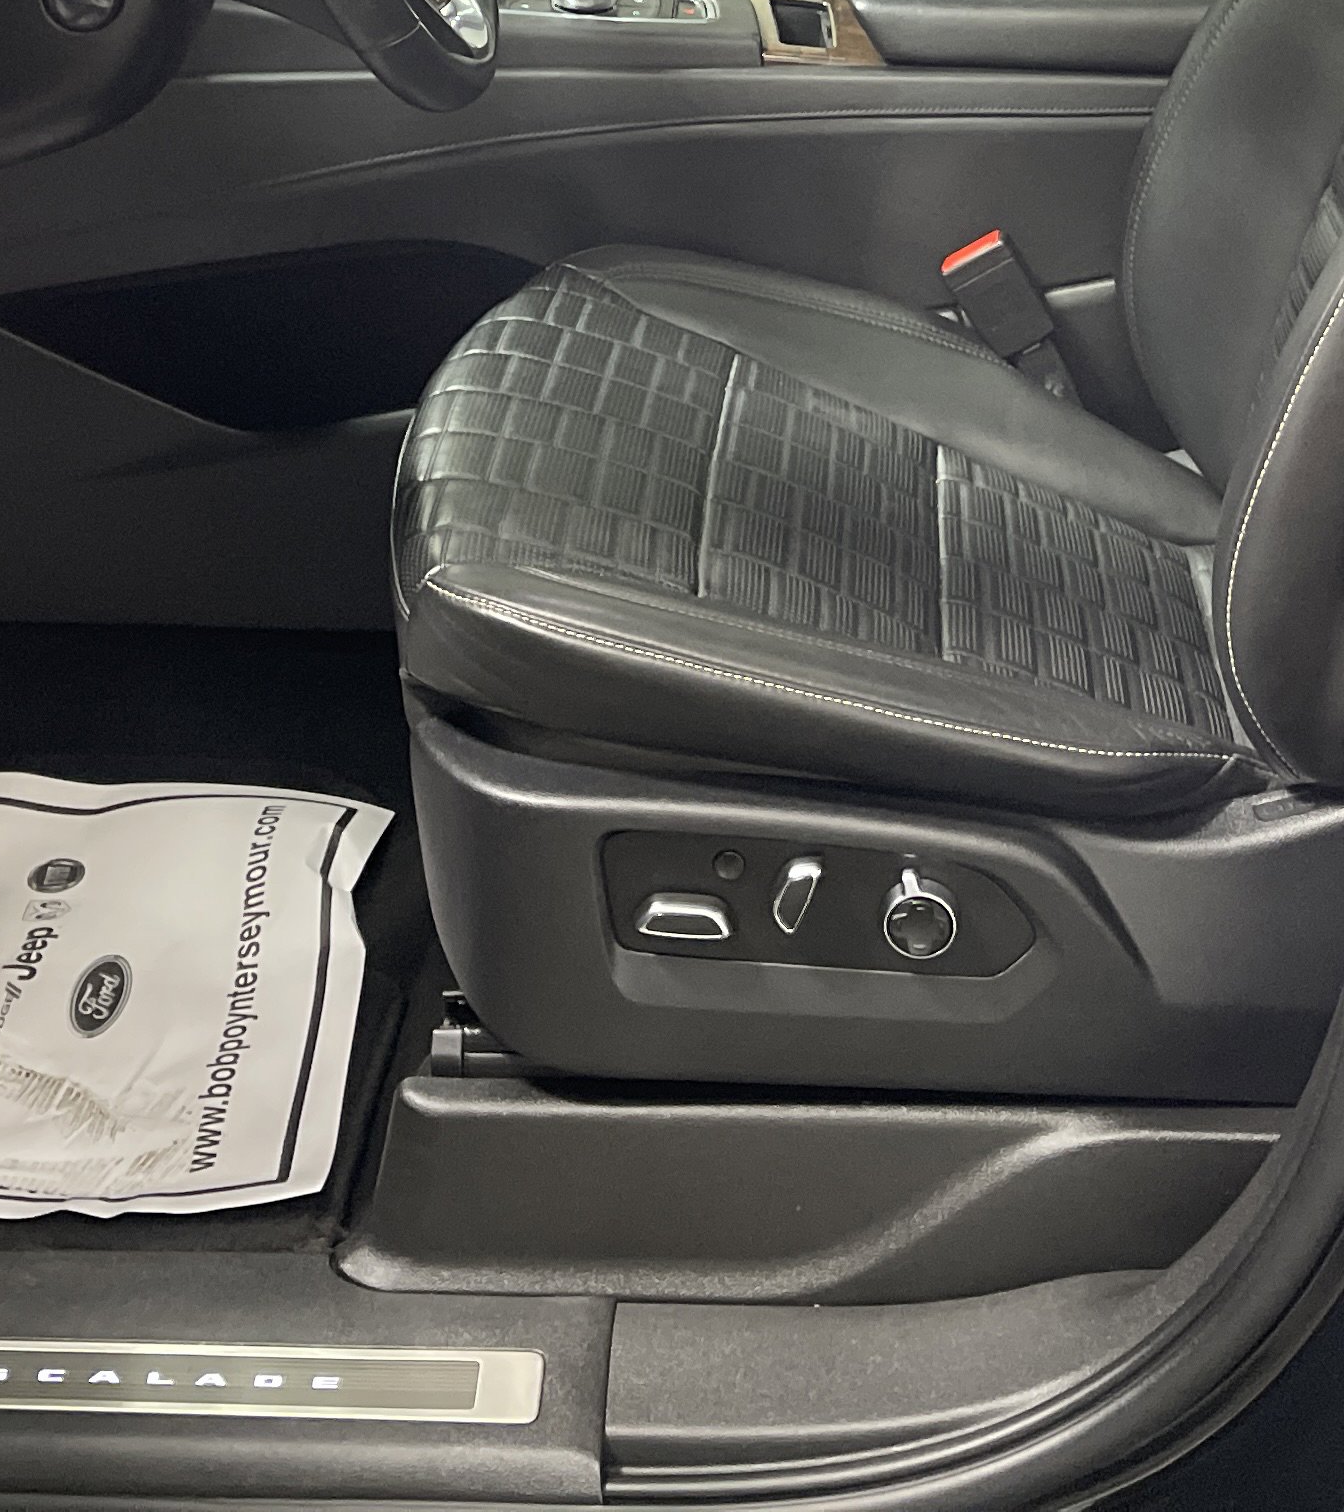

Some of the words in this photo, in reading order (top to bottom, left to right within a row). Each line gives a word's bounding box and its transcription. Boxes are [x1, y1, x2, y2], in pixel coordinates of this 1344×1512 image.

[2, 926, 59, 981] Jeep
[78, 972, 121, 1021] Ford
[189, 804, 287, 1174] www.bobpoynterseymour.com
